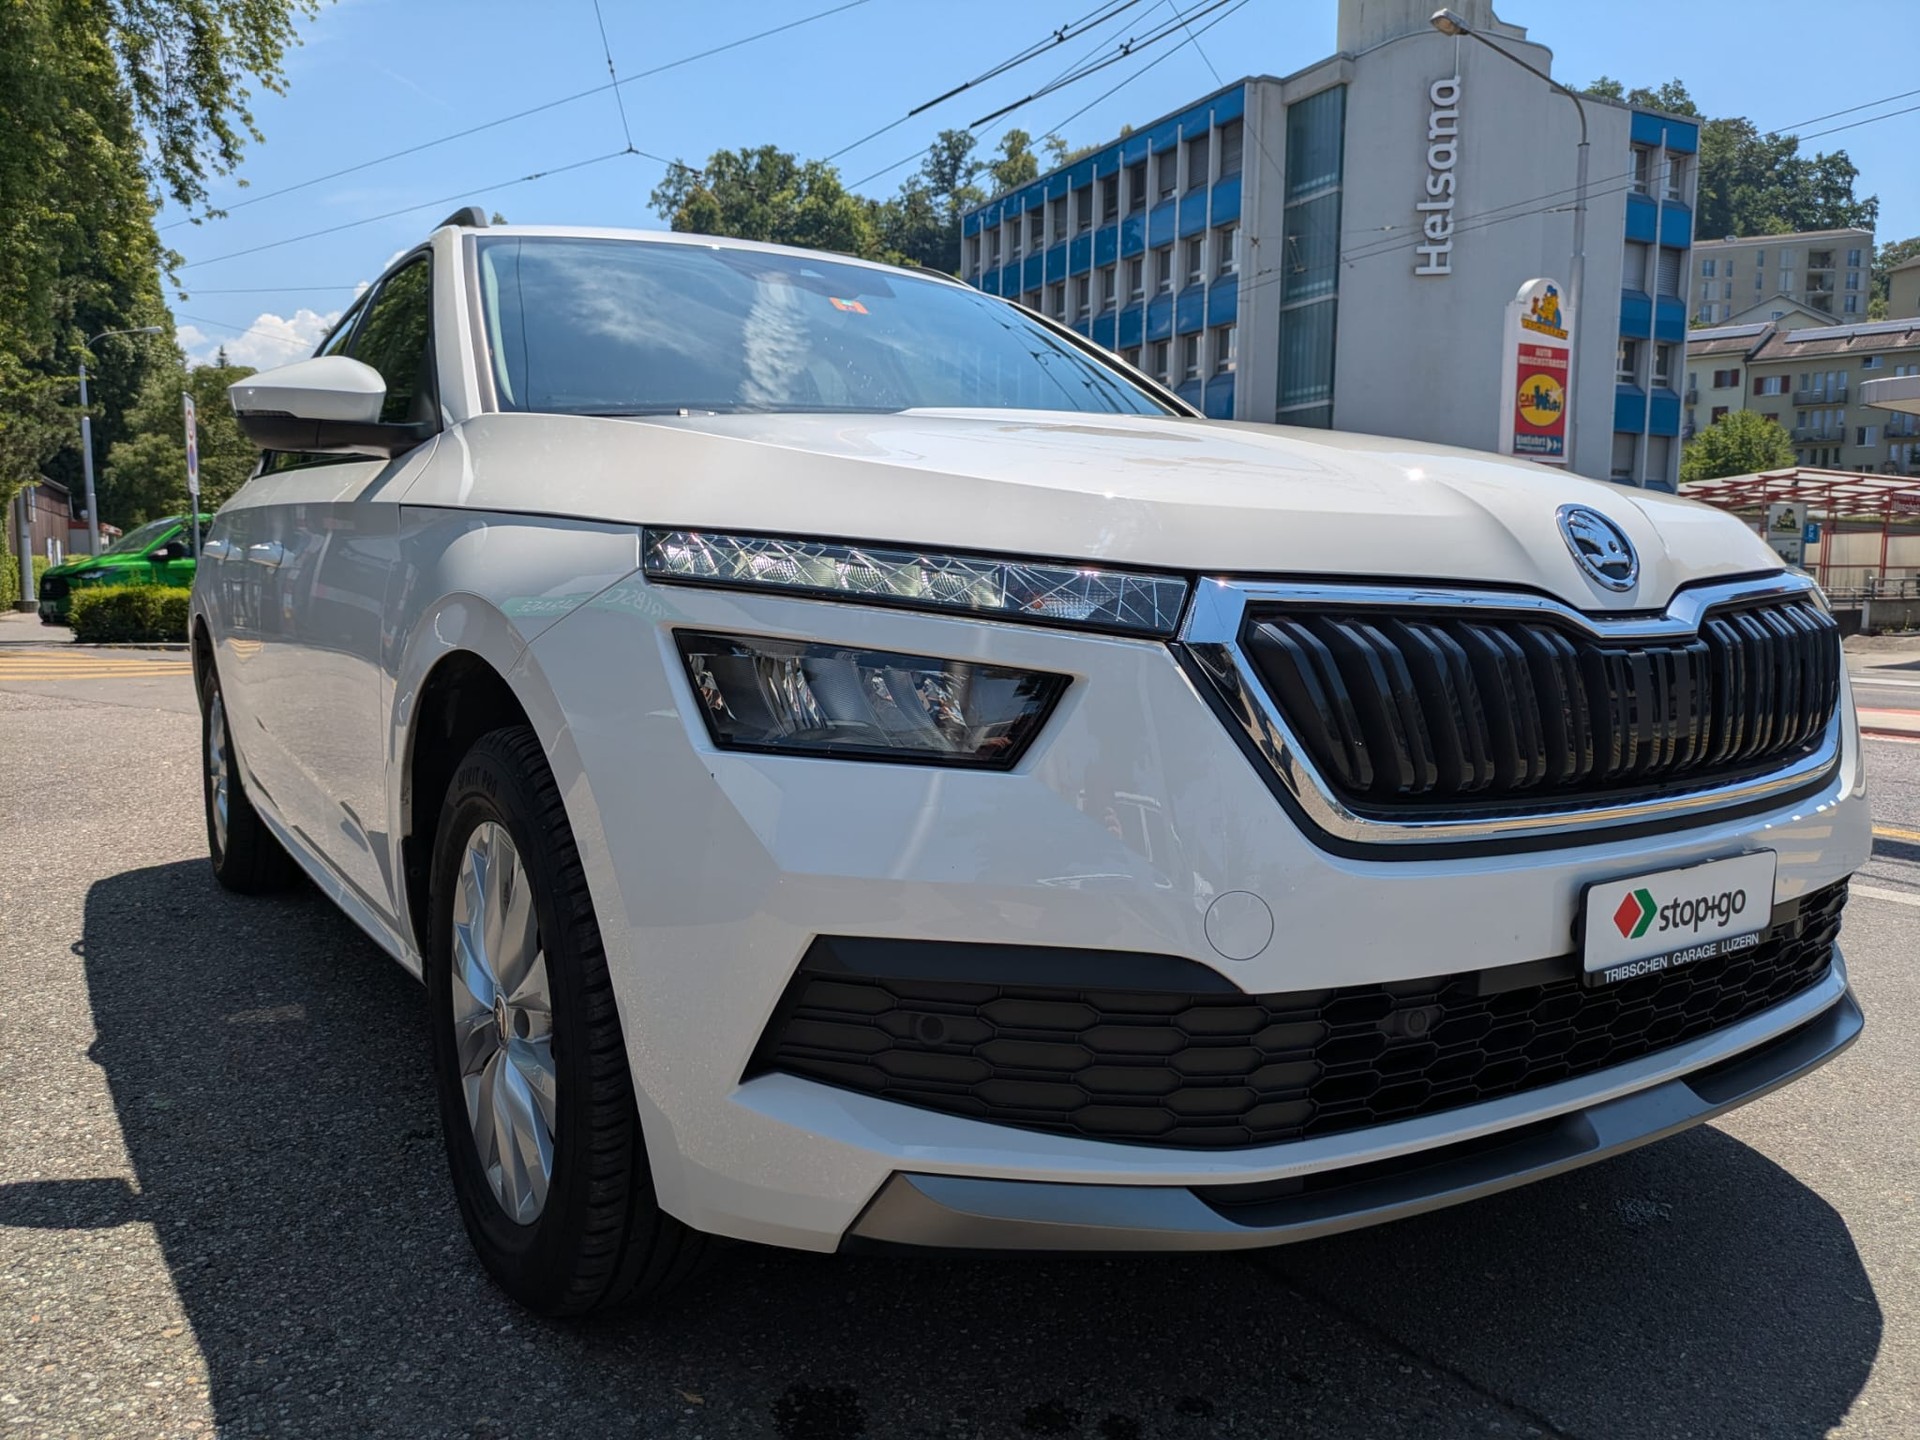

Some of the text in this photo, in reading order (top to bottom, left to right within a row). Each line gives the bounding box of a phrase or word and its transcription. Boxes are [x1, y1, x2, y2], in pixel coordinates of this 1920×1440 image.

[1415, 76, 1461, 275] Helsana
[1659, 889, 1746, 933] stop+go
[1604, 933, 1760, 984] TRIBSCHEN GARAGE LUZERN
